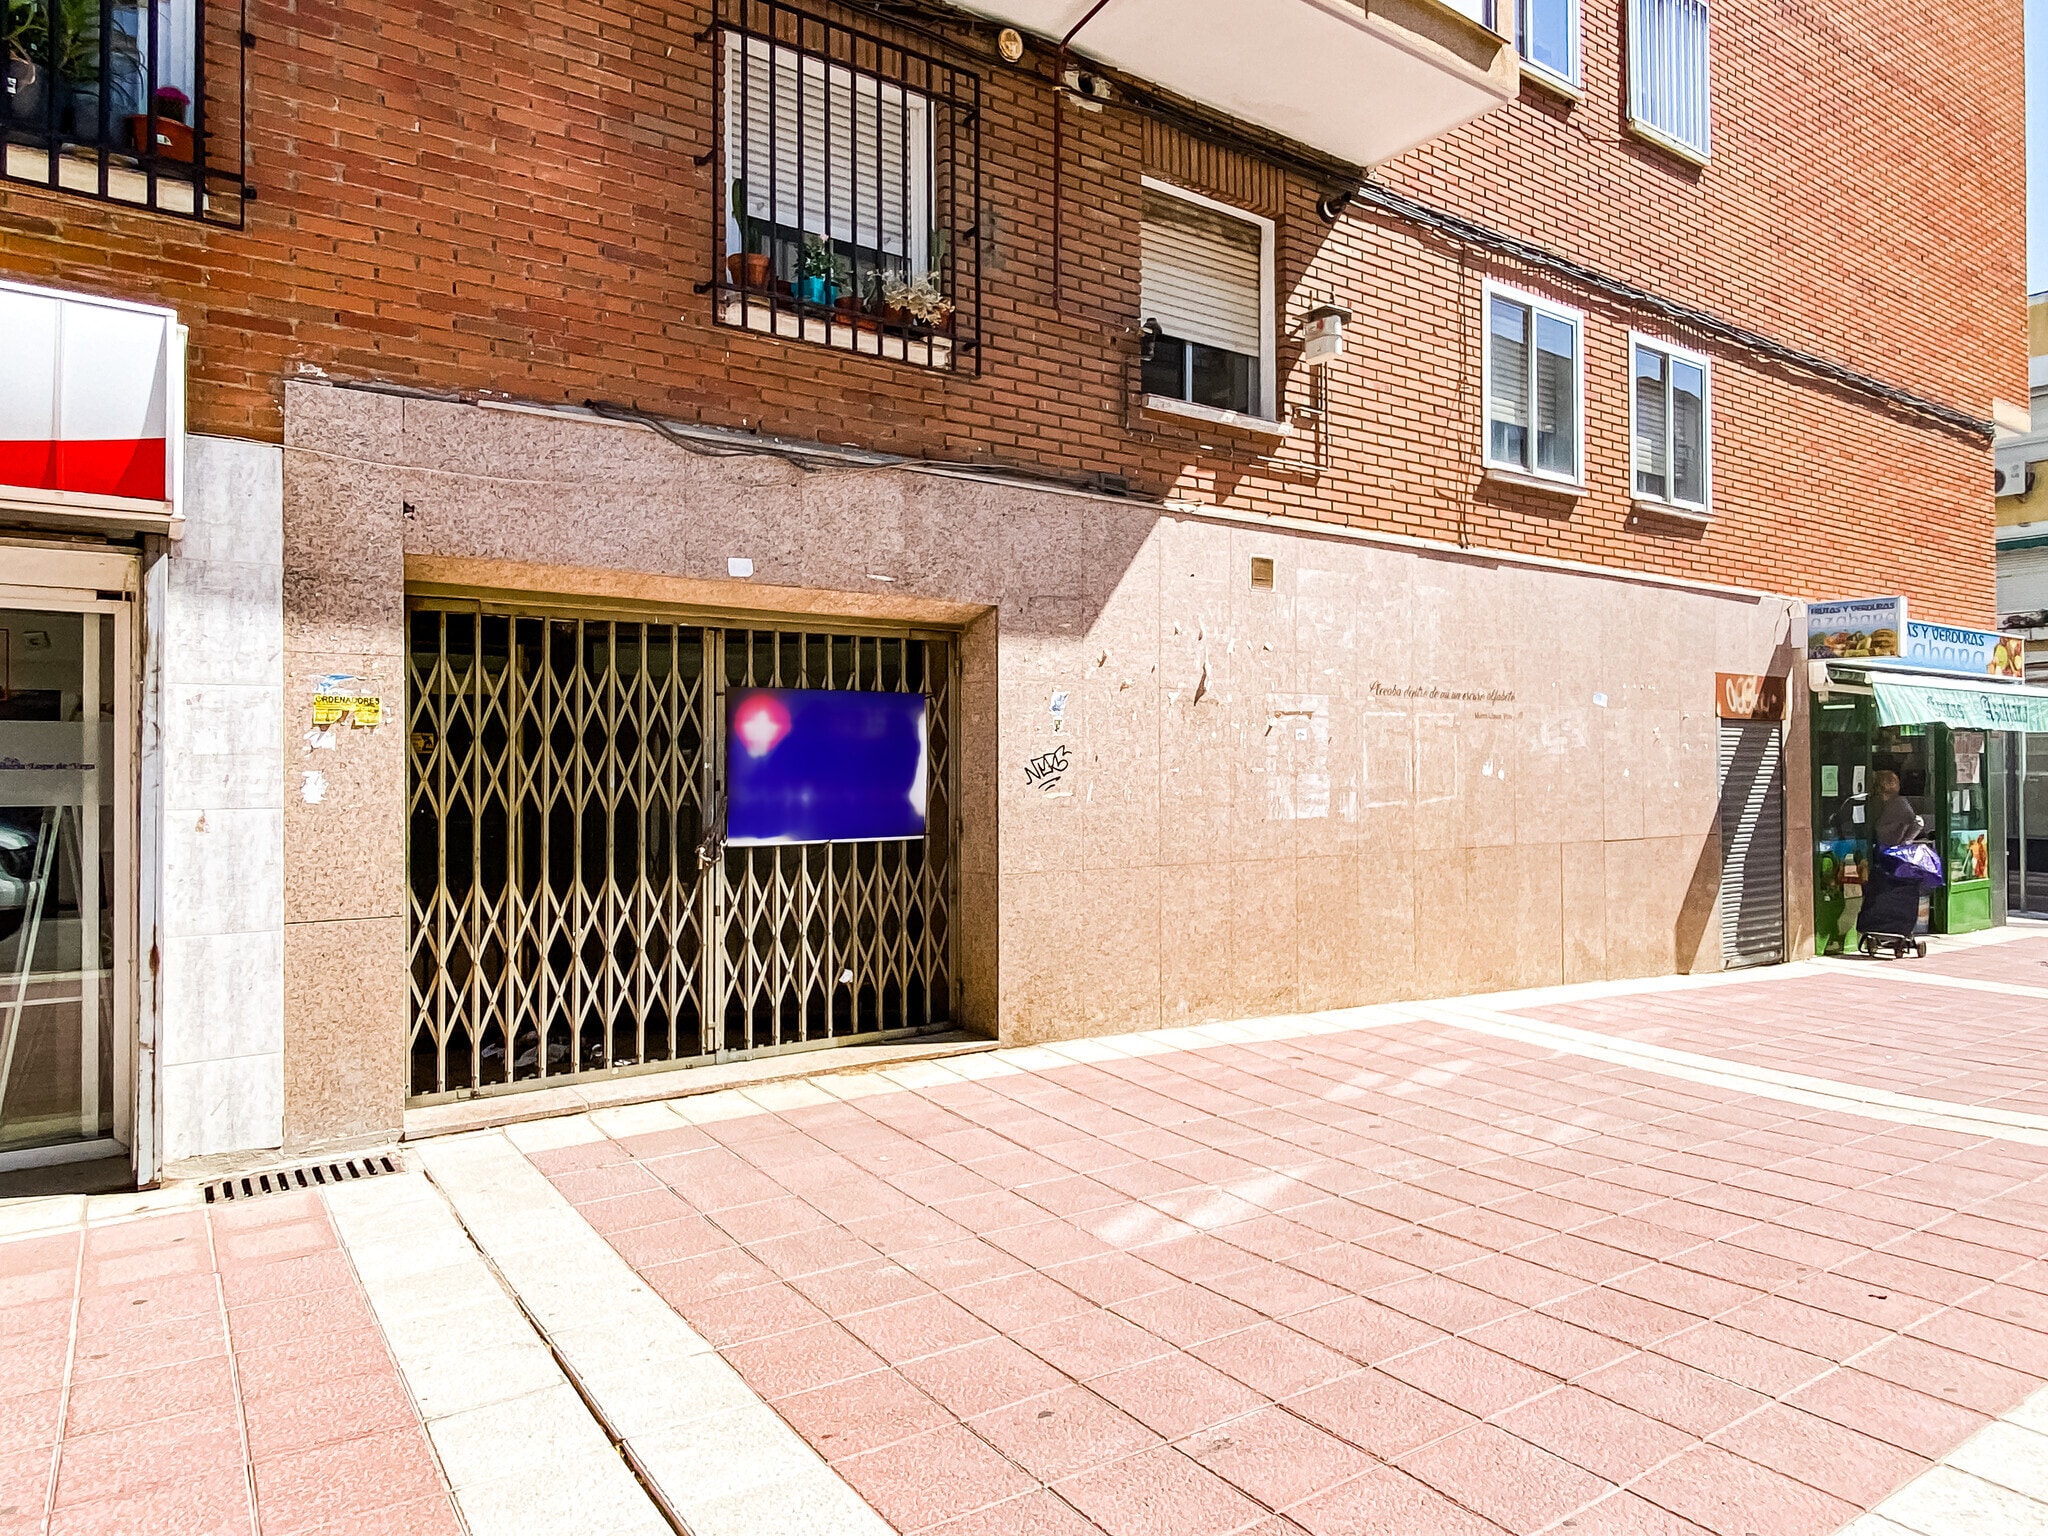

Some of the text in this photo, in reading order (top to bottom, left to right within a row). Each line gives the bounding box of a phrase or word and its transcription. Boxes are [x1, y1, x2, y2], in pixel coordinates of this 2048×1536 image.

[1811, 606, 1840, 615] FRUTAS
[1851, 602, 1895, 611] VERDURAS
[1922, 626, 1929, 639] Y
[1932, 626, 1985, 647] VERDURAS
[315, 695, 380, 705] ORDENADORES
[56, 762, 67, 770] de
